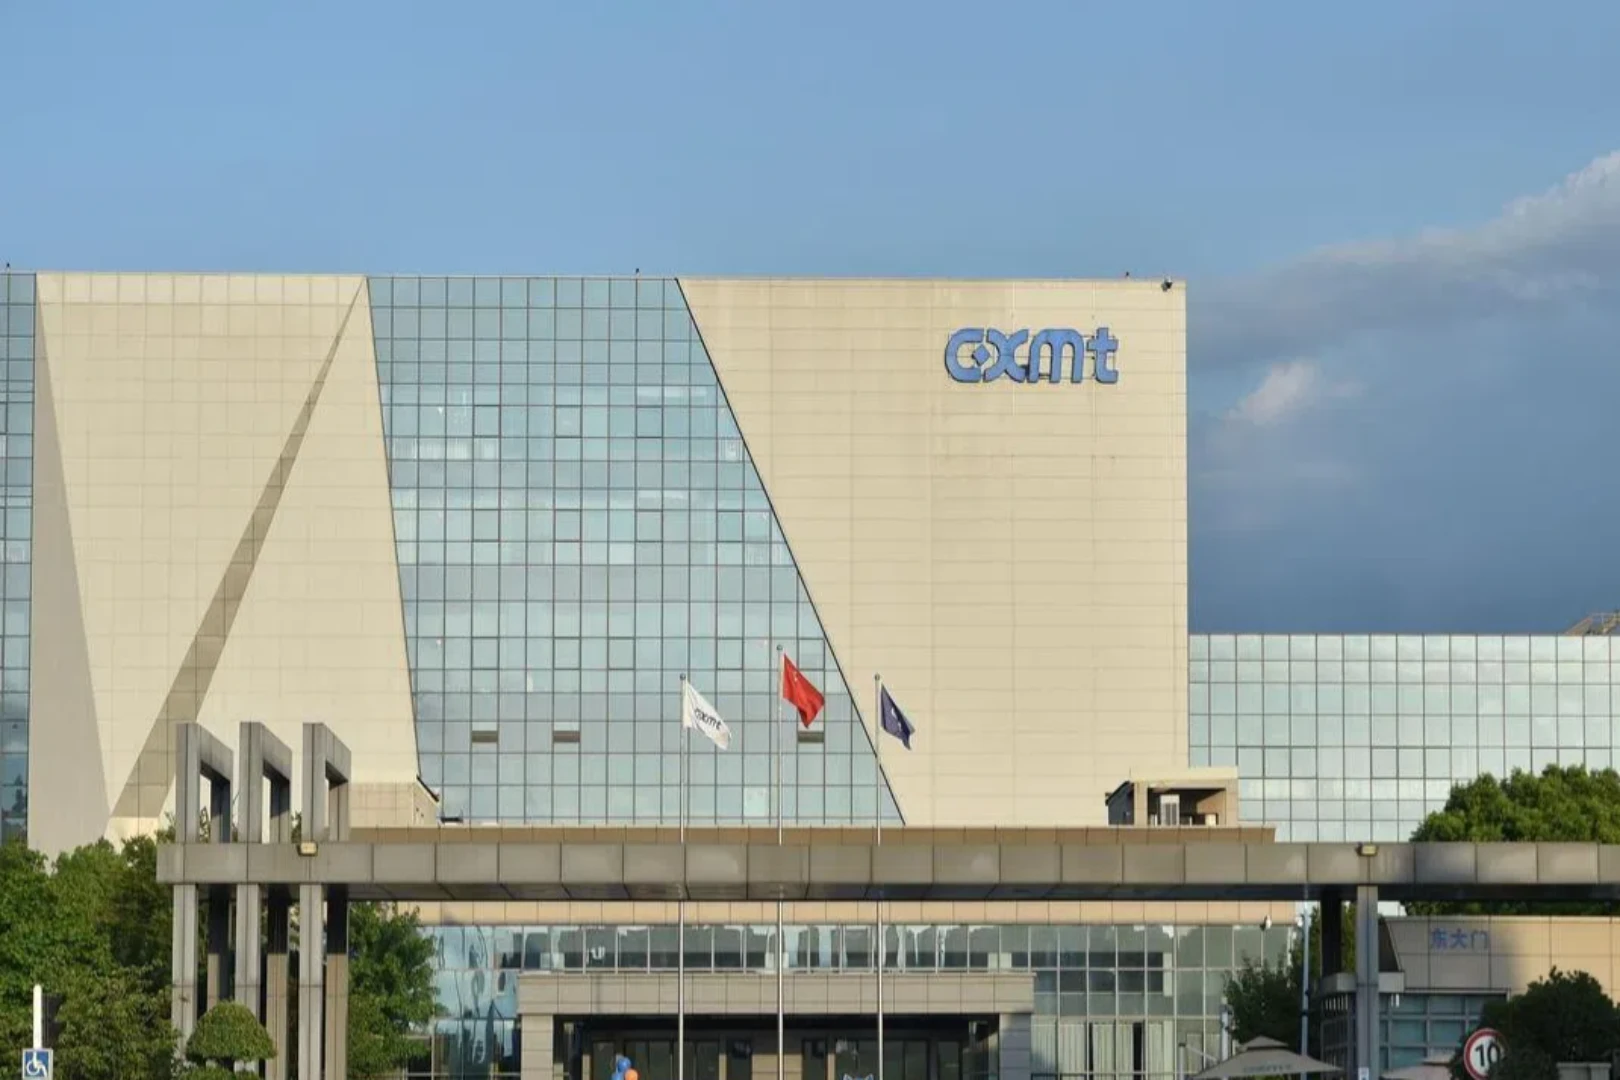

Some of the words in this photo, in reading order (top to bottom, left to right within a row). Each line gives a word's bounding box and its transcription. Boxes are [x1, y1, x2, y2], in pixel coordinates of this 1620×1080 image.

[945, 327, 1118, 383] cxmt
[1431, 928, 1488, 950] 东大门
[1475, 1040, 1501, 1068] 10
